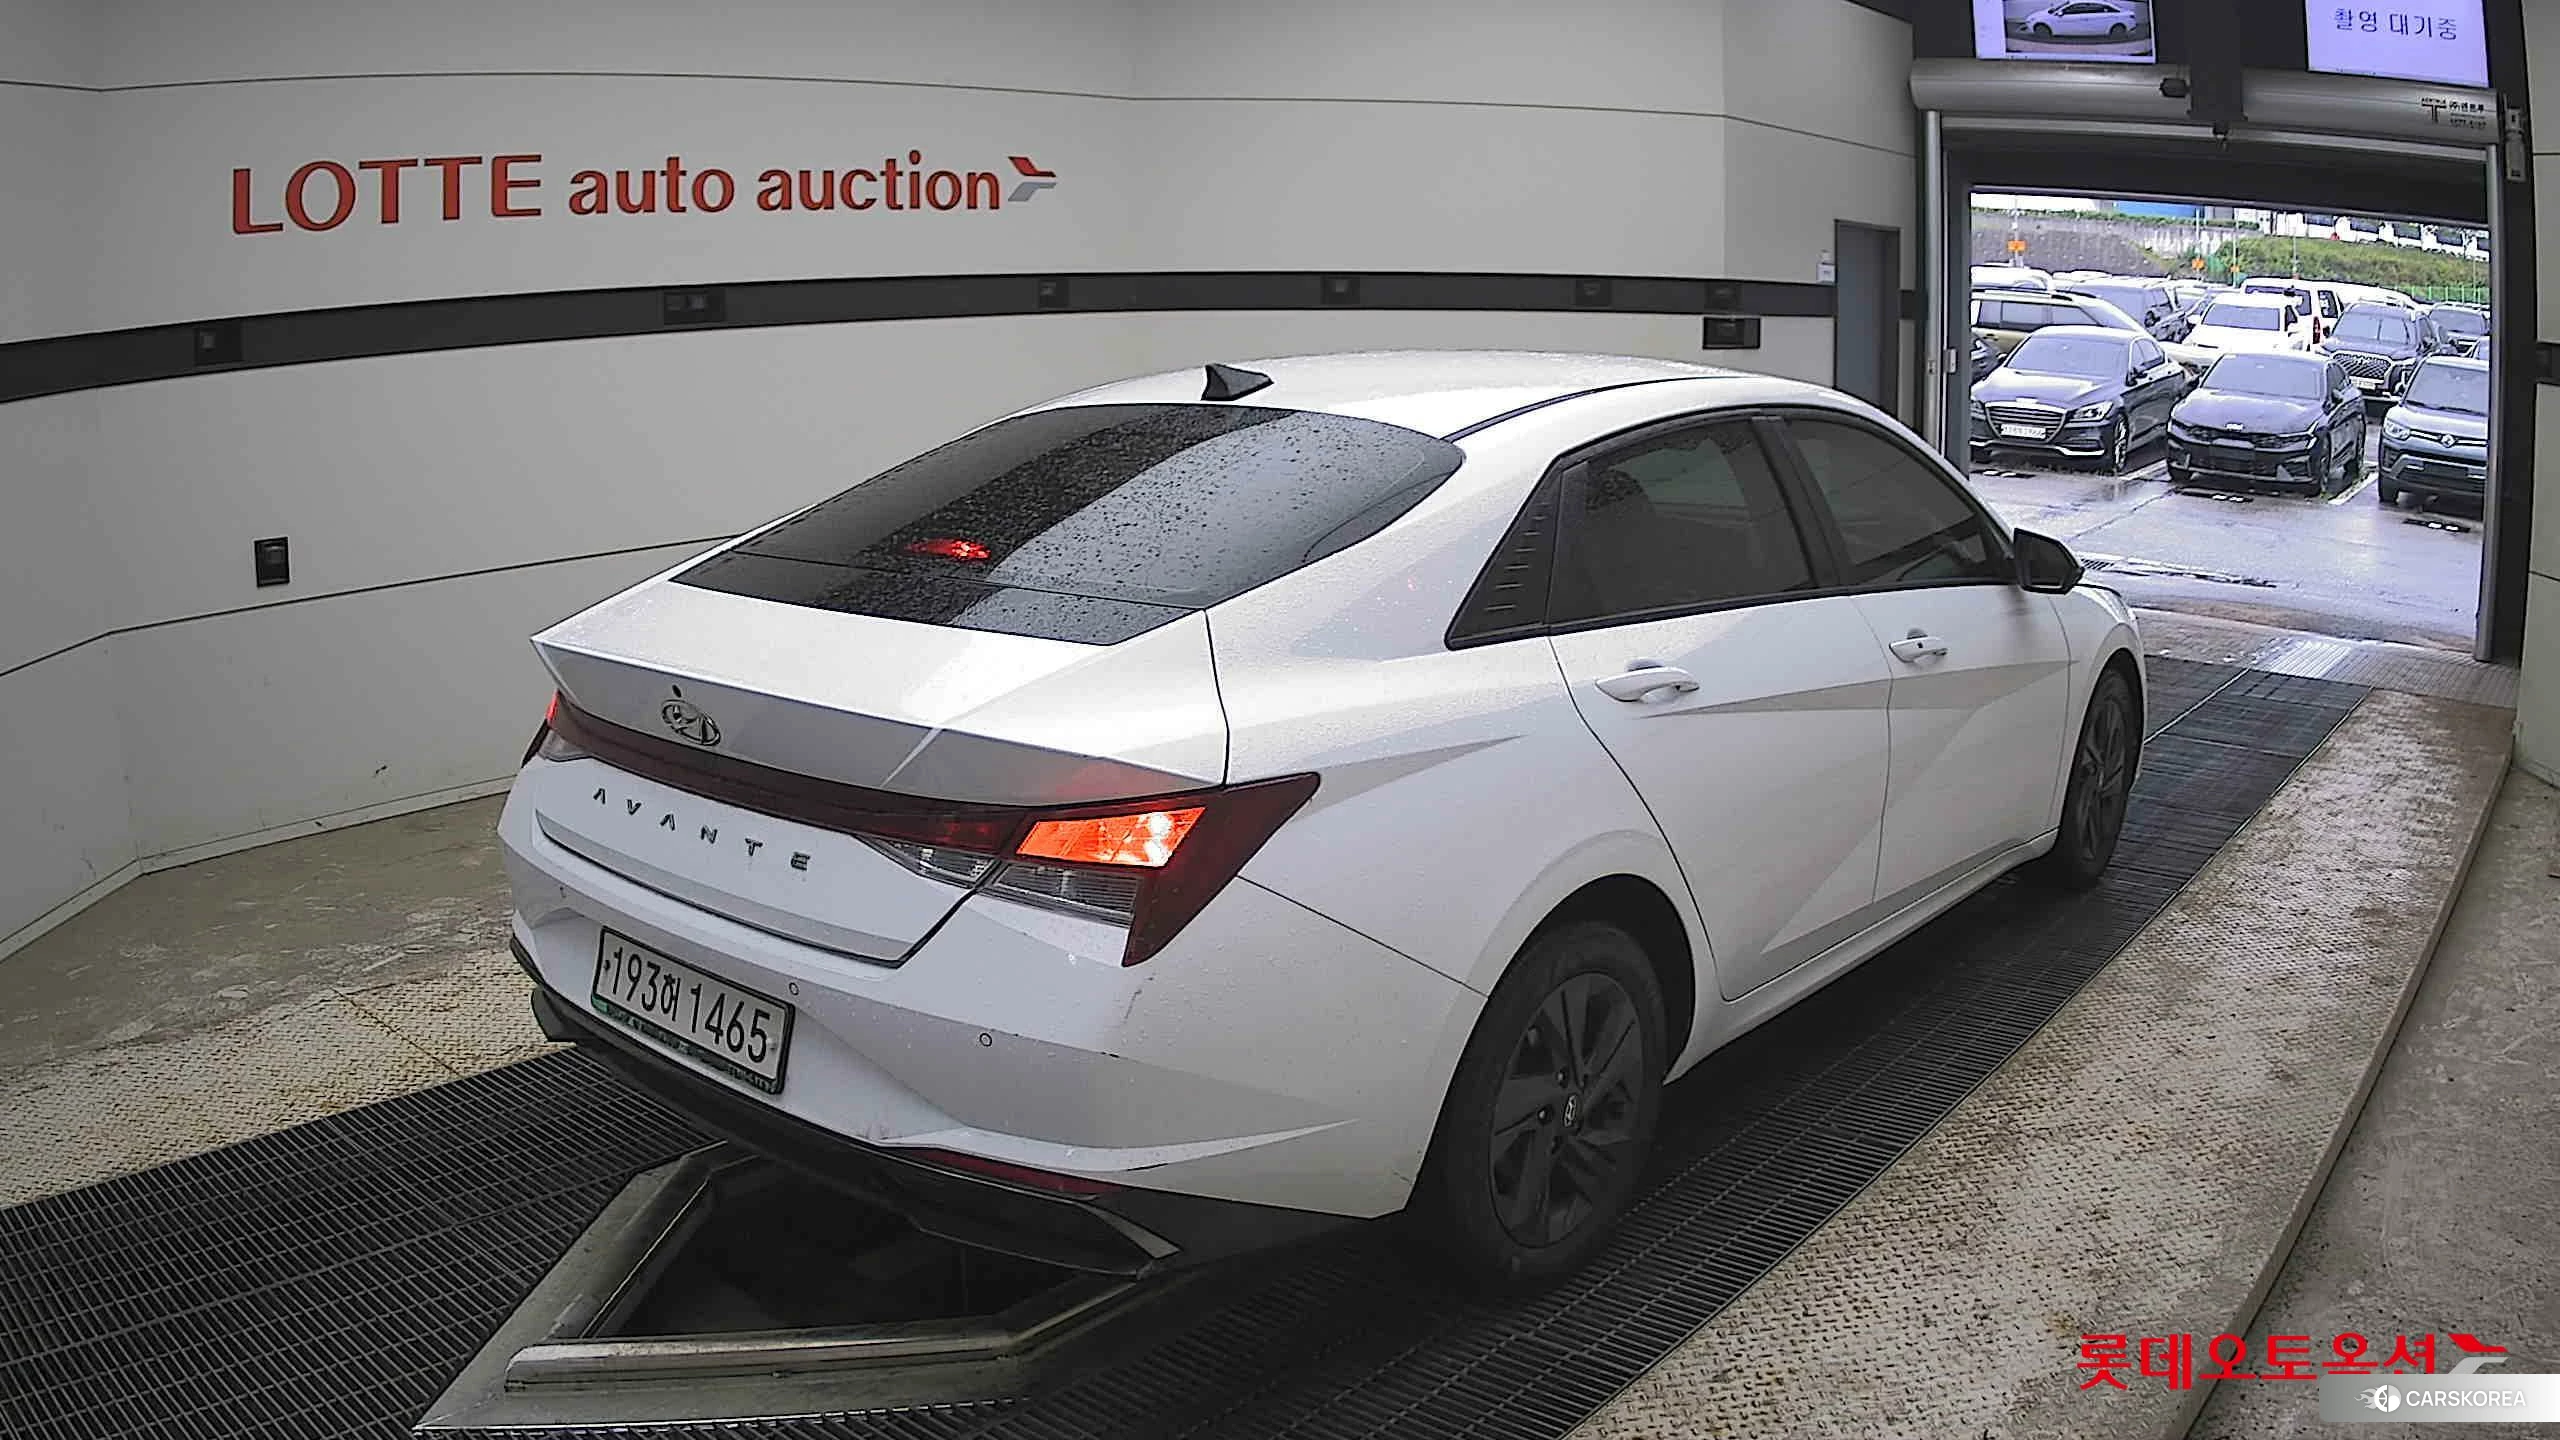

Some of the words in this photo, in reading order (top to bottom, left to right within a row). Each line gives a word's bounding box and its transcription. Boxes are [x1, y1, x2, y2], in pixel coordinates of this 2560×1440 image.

[2335, 8, 2378, 32] 촬영
[2389, 13, 2457, 40] 대기중
[232, 154, 542, 235] LOTTE
[568, 156, 735, 215] auto
[757, 149, 1000, 211] auction
[593, 787, 812, 871] AVANTE
[690, 983, 771, 1063] 1465
